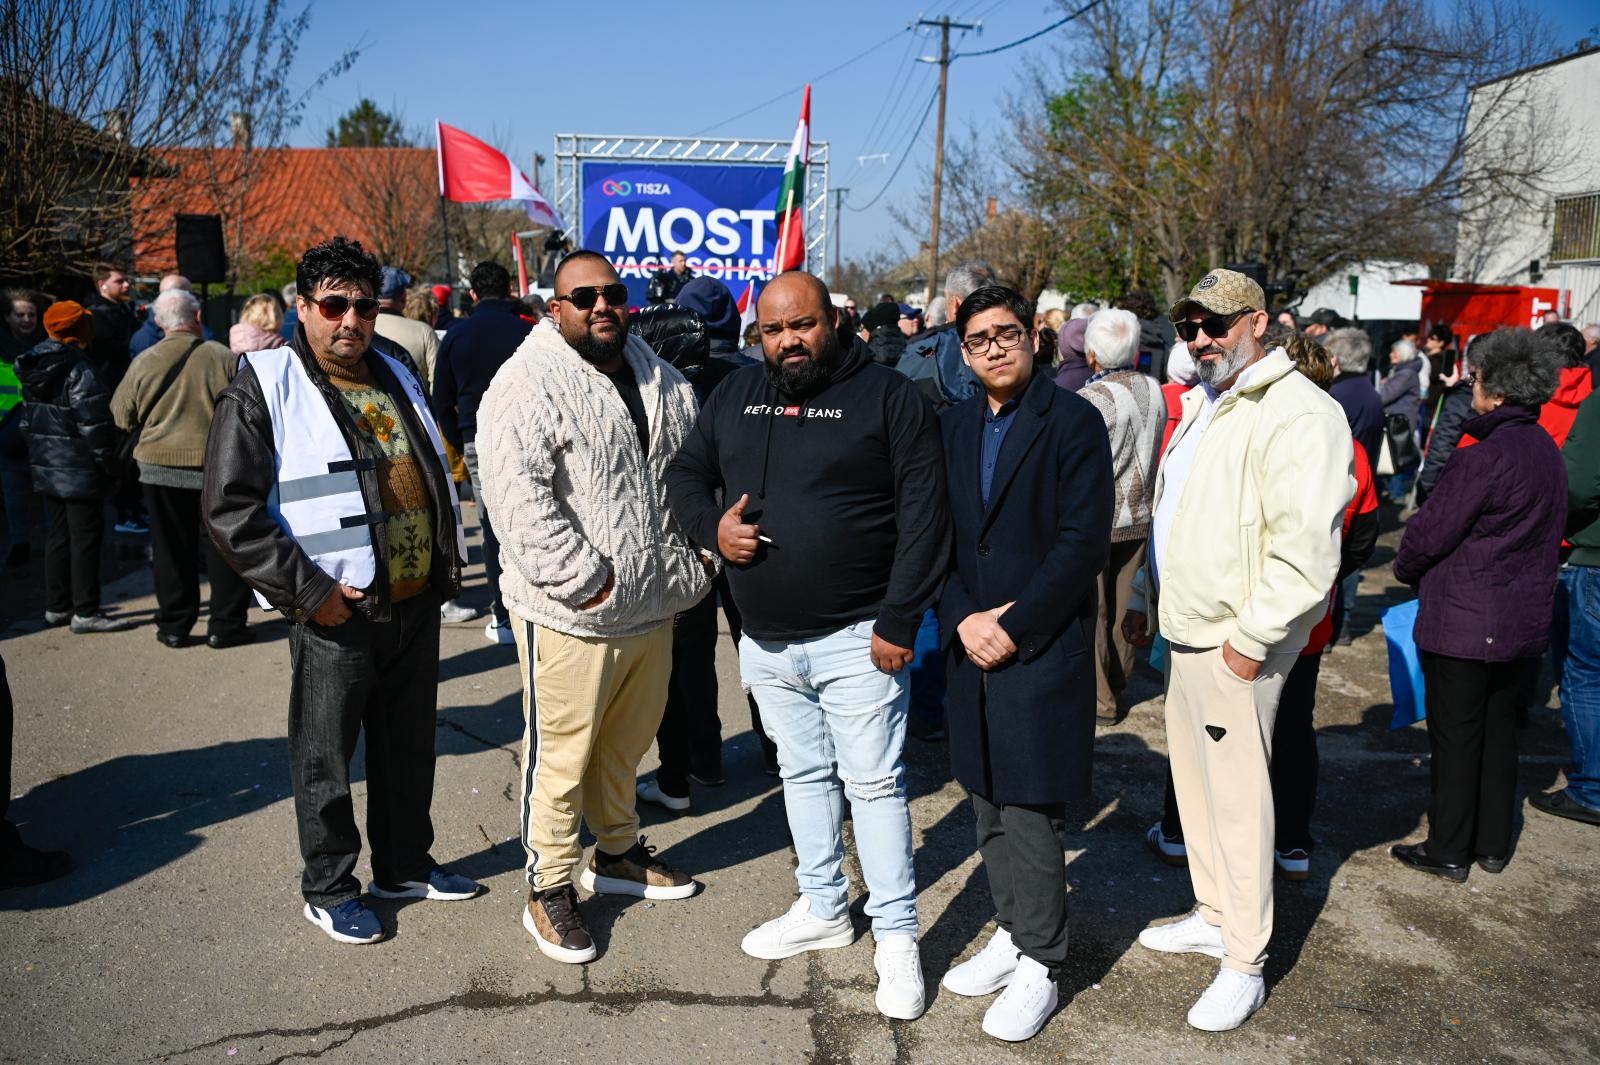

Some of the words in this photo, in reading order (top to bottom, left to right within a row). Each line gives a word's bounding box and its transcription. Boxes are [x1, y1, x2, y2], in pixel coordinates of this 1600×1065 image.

[635, 183, 671, 195] TISZA
[604, 207, 776, 255] MOST
[686, 257, 774, 281] SOHA!
